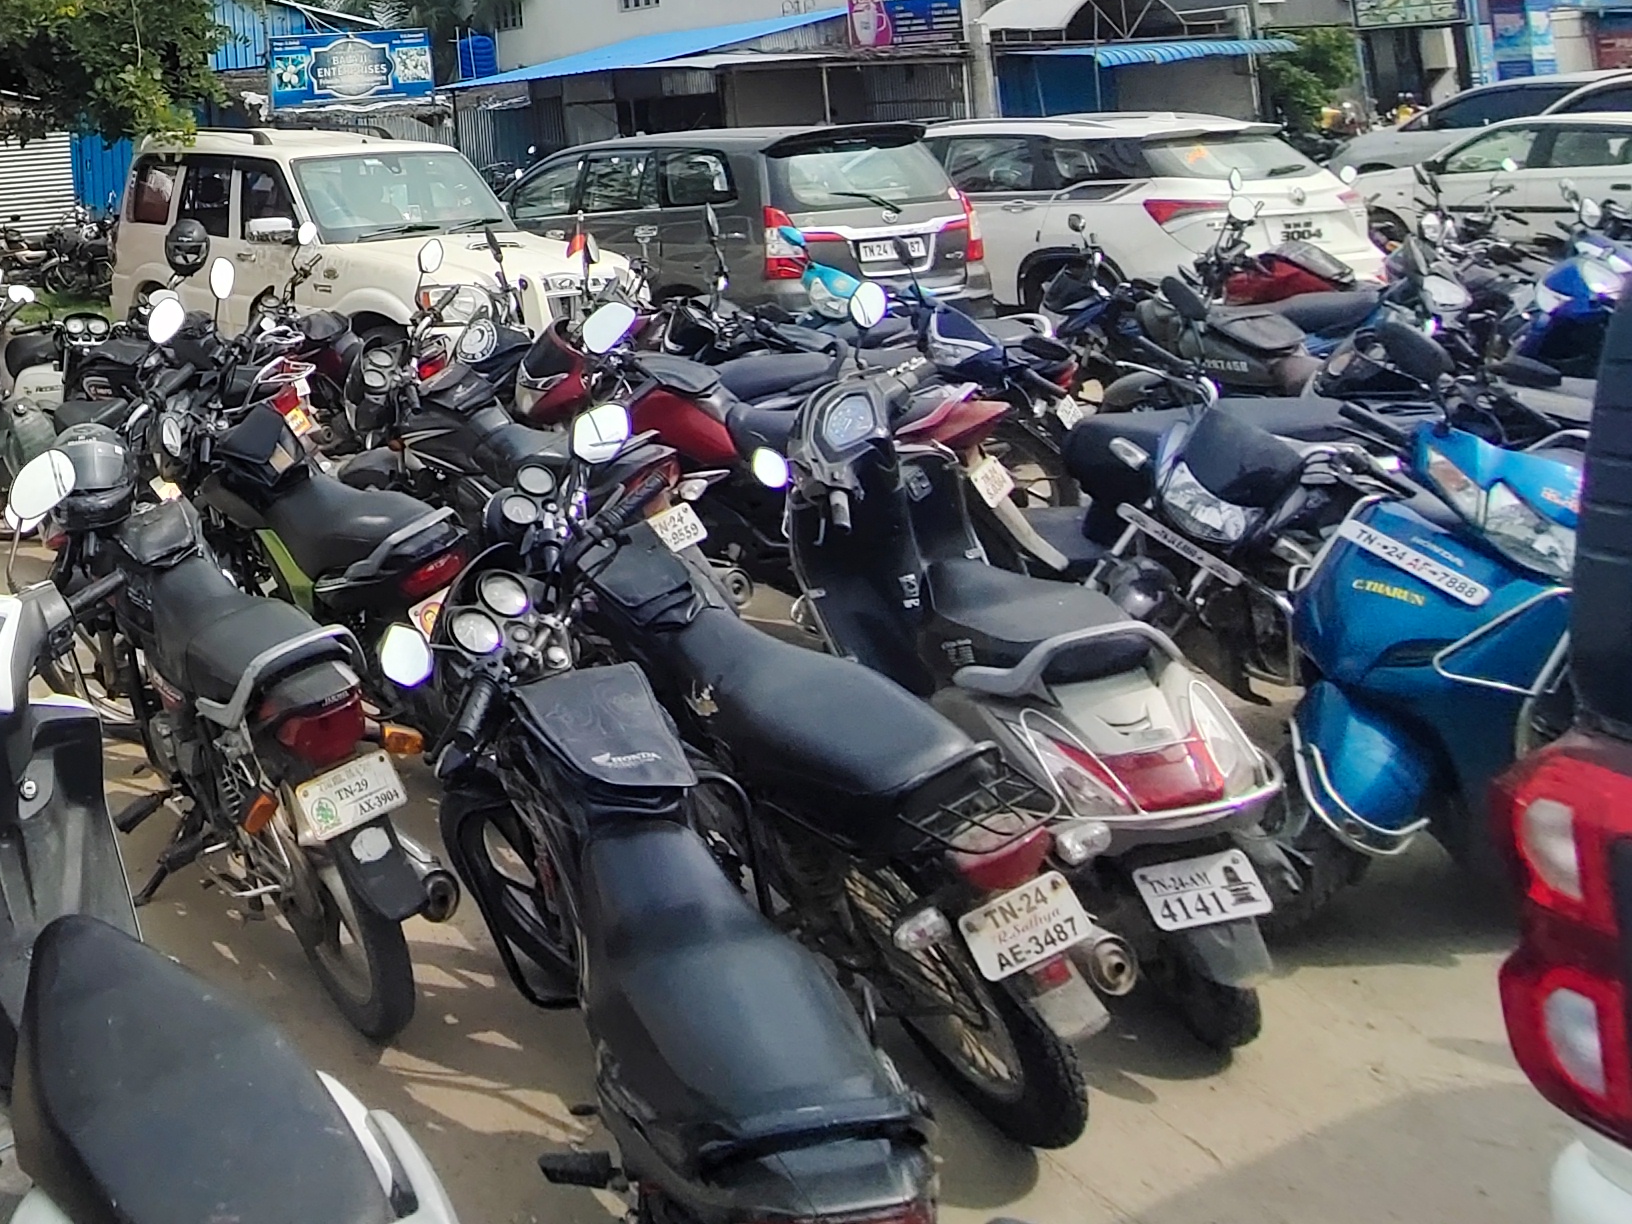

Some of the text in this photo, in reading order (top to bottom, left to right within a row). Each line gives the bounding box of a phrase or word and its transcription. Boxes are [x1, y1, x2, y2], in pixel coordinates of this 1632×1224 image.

[317, 64, 387, 78] ENTERPRISES
[862, 244, 875, 257] TN
[876, 244, 888, 256] 24
[655, 512, 685, 535] N-24
[335, 778, 369, 801] TN-29
[358, 789, 400, 815] AX-3904
[983, 886, 1049, 929] TN-24
[1160, 891, 1228, 923] 4141
[996, 916, 1078, 972] AE-3487
